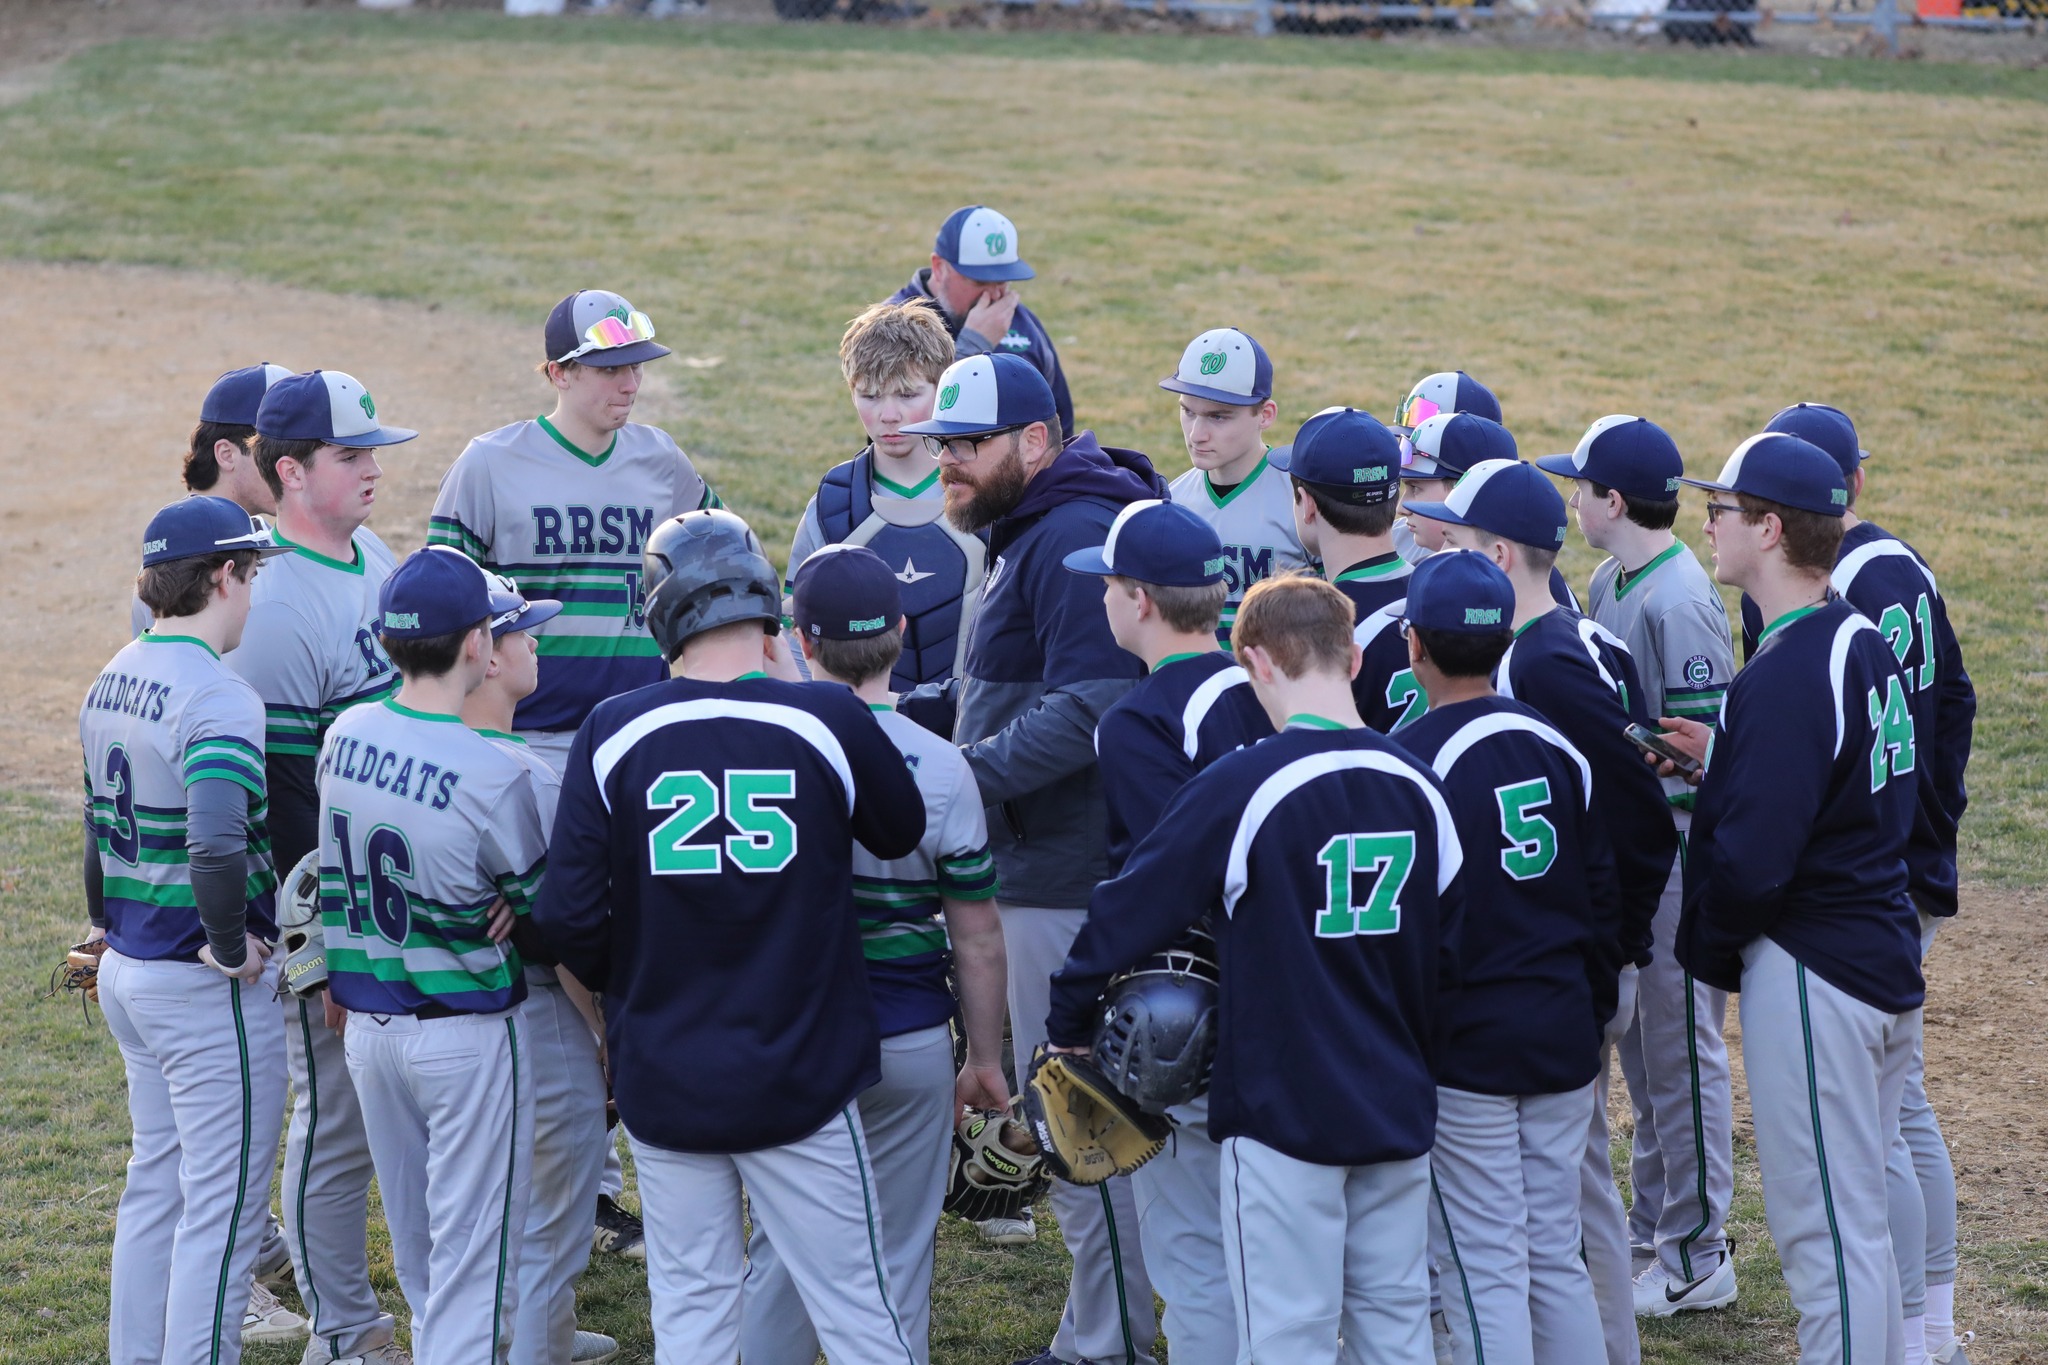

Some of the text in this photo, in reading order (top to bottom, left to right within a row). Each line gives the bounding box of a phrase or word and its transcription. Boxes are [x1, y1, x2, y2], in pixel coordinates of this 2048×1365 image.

[1353, 465, 1388, 483] RRSM
[531, 504, 654, 557] RRSM
[385, 611, 420, 629] RRSM
[849, 615, 886, 632] RRSM
[1464, 608, 1502, 624] RRSM
[1879, 592, 1935, 693] 21
[87, 672, 173, 723] WILDCATS
[1868, 674, 1915, 794] 24
[105, 741, 140, 868] 3
[647, 769, 797, 875] 25
[1494, 777, 1558, 881] 5
[329, 807, 414, 948] 16
[1315, 831, 1416, 939] 17
[288, 956, 323, 981] Wilson
[983, 1148, 1019, 1175] Wilson
